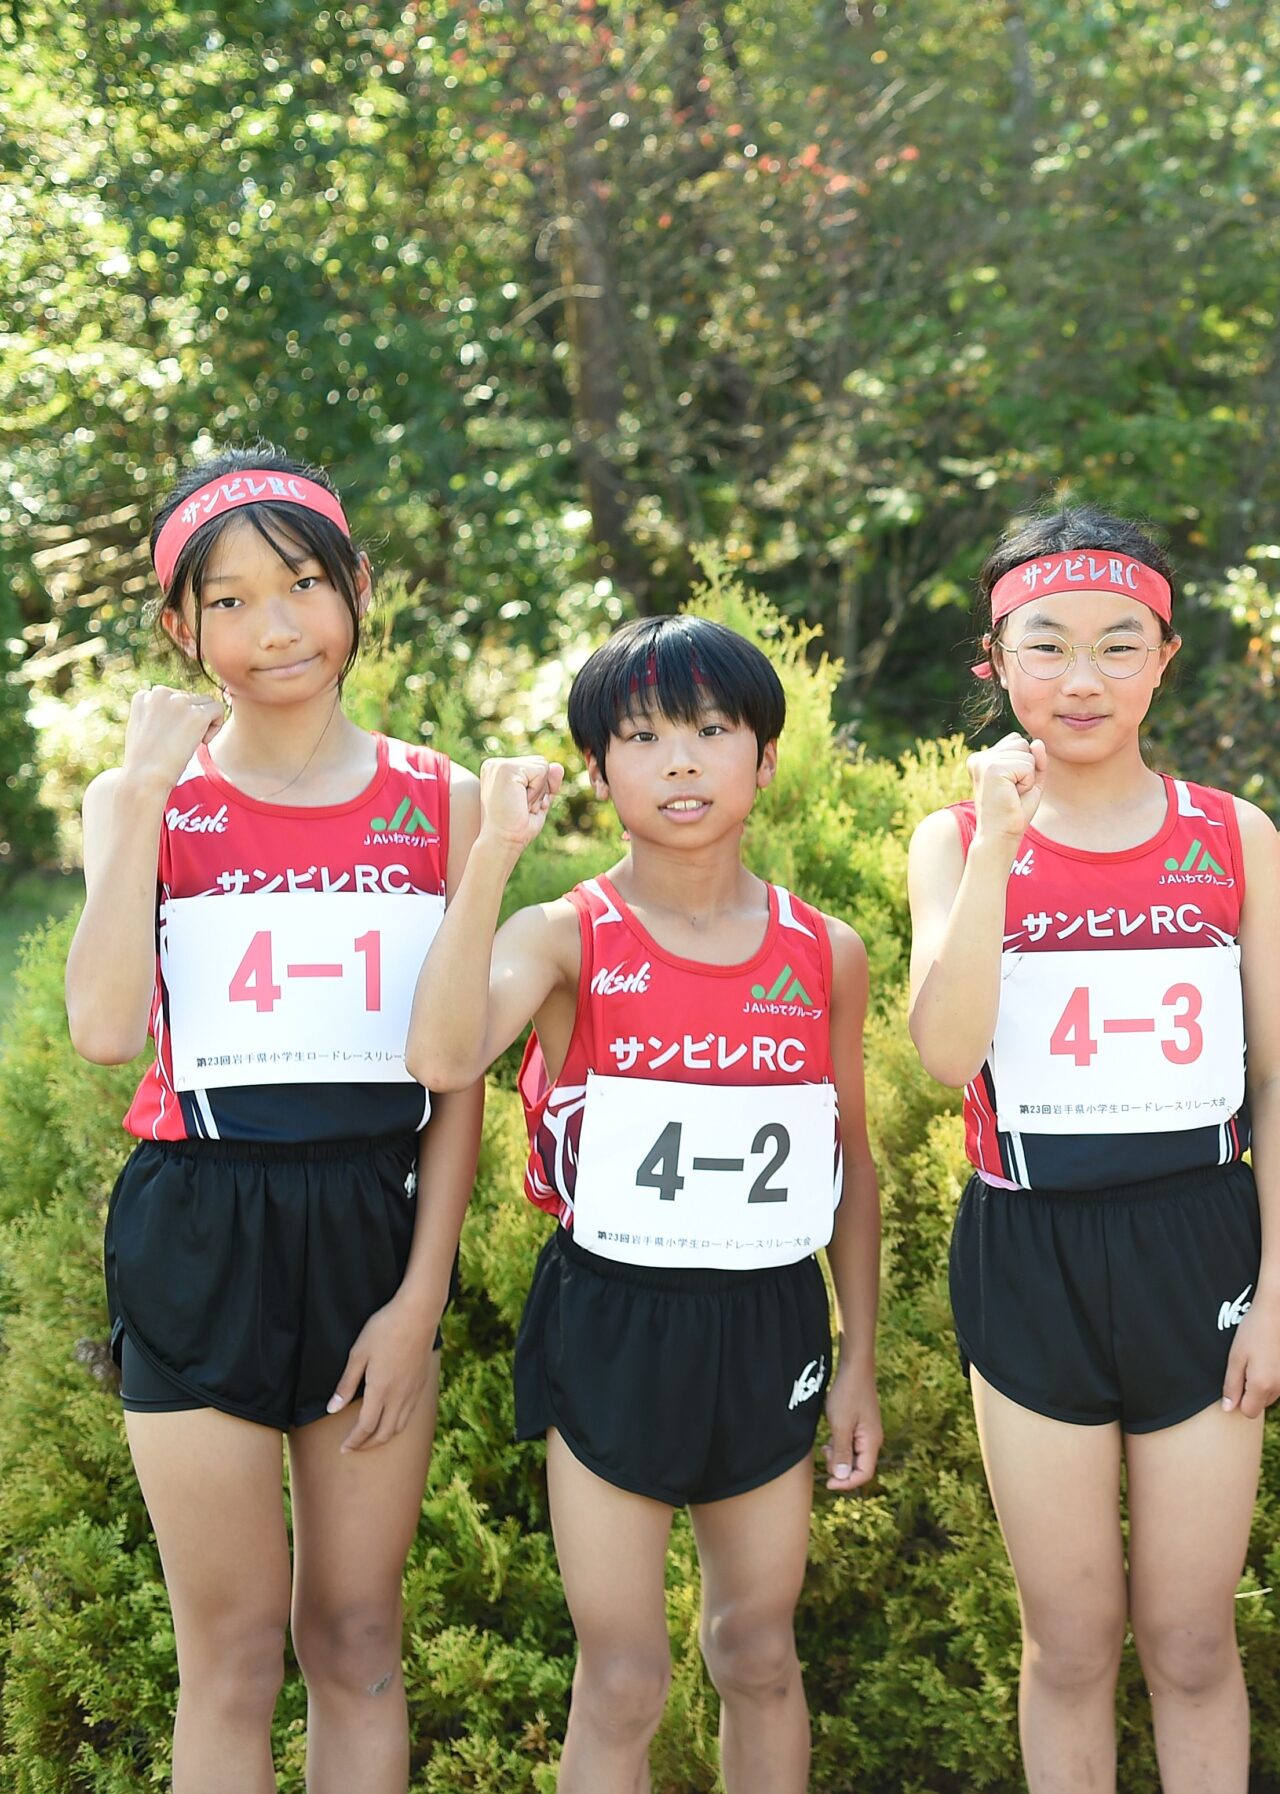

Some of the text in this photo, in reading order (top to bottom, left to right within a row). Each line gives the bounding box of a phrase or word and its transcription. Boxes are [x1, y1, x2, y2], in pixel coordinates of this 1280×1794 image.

[181, 476, 306, 525] サンビレRC
[1022, 554, 1140, 591] サンビレRC
[217, 864, 411, 894] サンビレRC
[1022, 903, 1203, 942] サンビレRC
[229, 930, 381, 1013] 4-1
[1050, 982, 1204, 1067] 4-3
[197, 1050, 406, 1067] 第23回岩手県小学生ロードレースリレー
[609, 1032, 806, 1073] サンビレRC
[636, 1121, 790, 1203] 4-2
